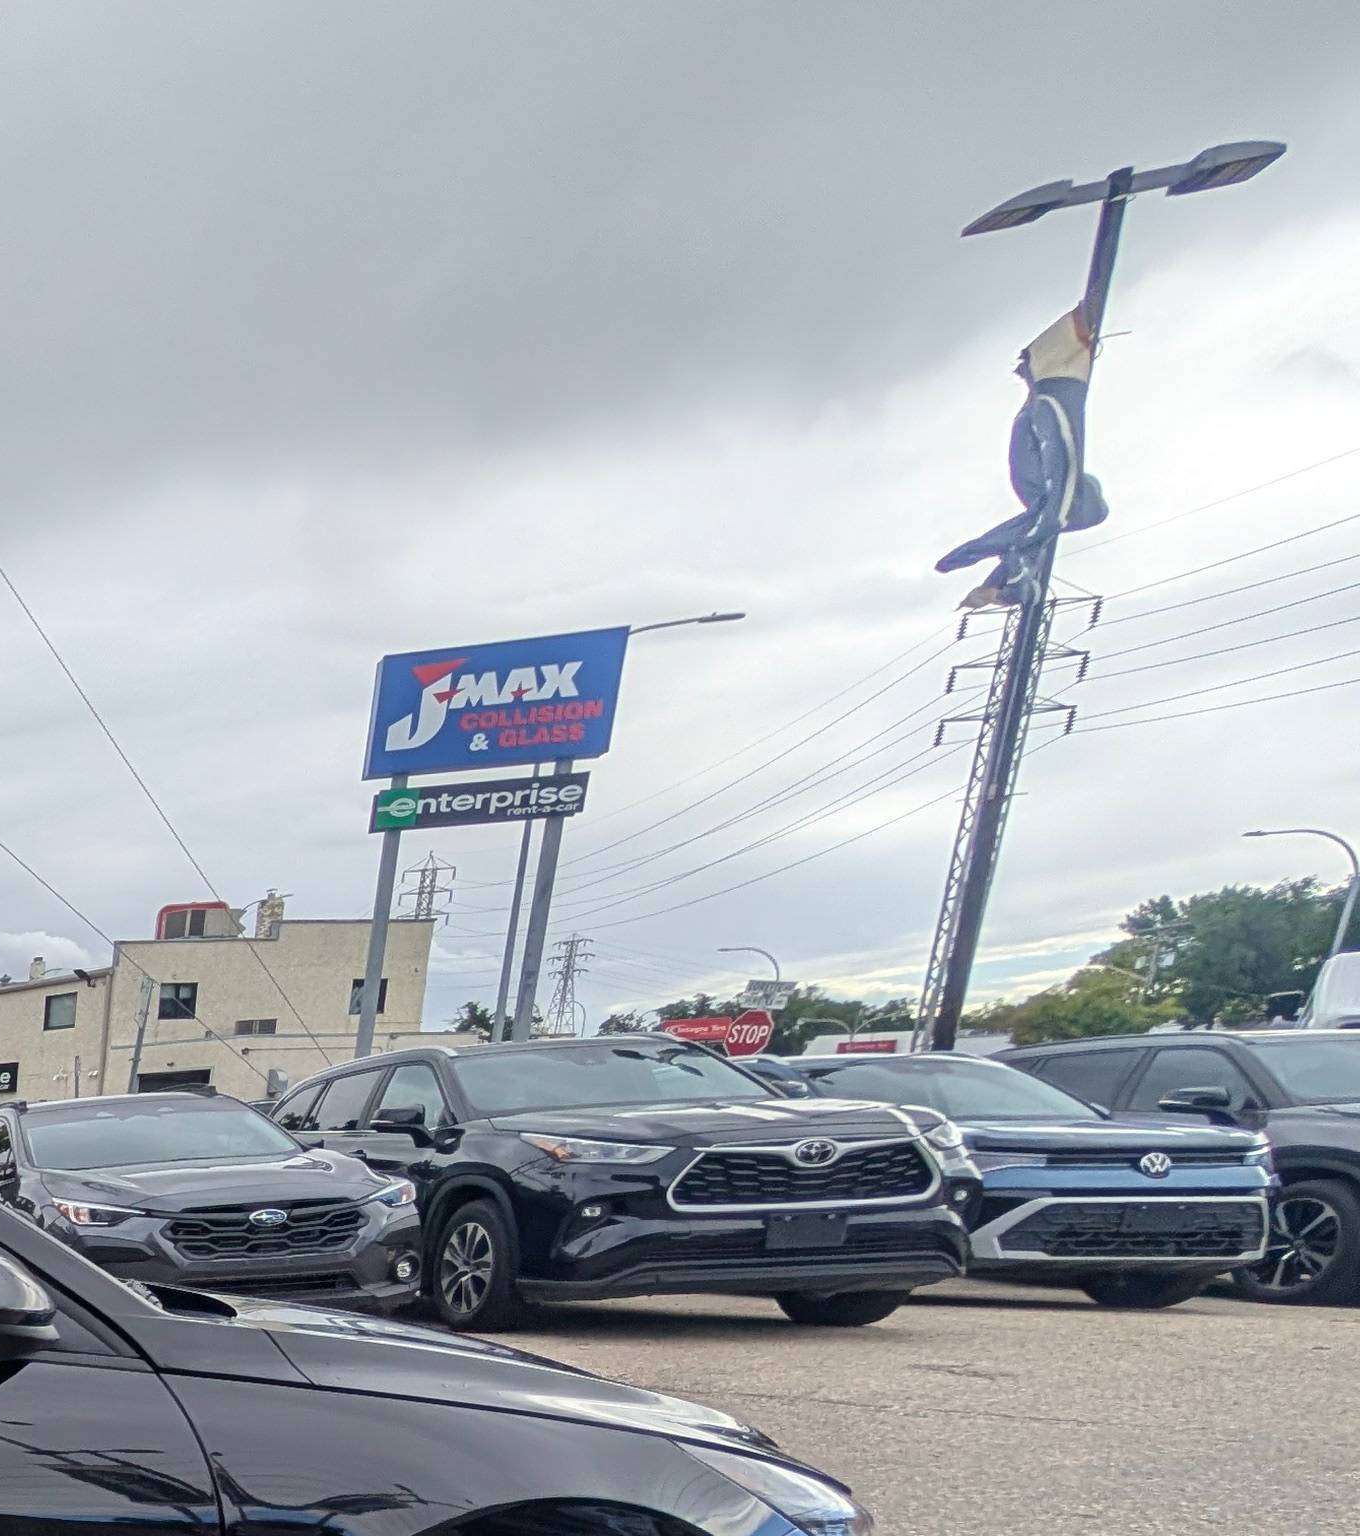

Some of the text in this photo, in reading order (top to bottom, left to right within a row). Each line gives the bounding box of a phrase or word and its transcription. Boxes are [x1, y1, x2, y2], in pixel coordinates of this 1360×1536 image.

[458, 699, 604, 732] COLLISION
[468, 723, 585, 752] & GLASS
[377, 783, 584, 818] enterprise
[506, 803, 579, 817] rent-a-car
[728, 1023, 769, 1045] STOP
